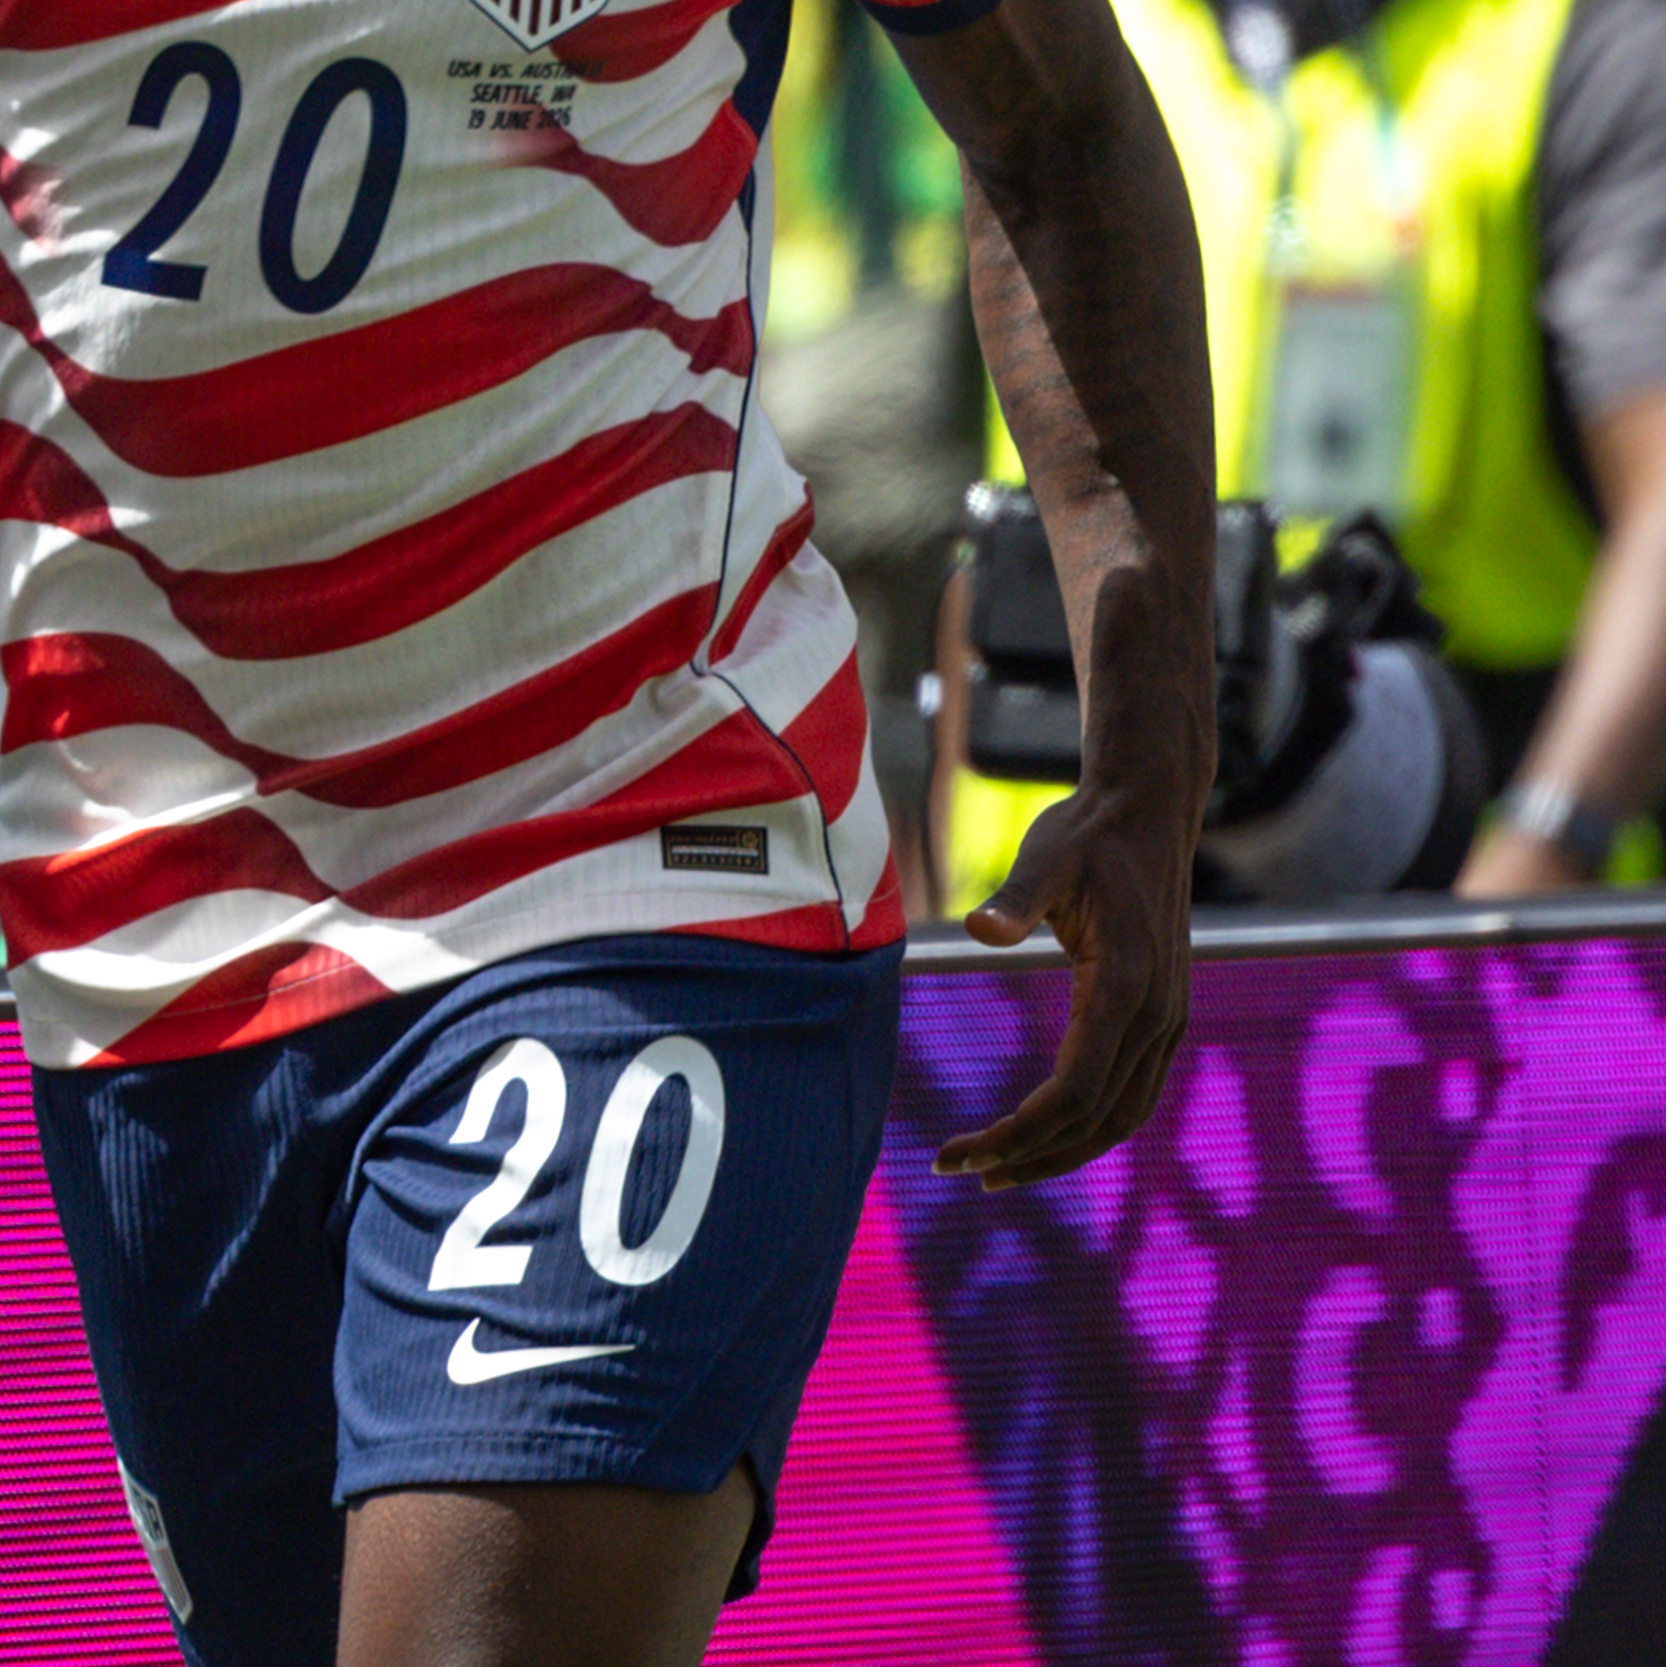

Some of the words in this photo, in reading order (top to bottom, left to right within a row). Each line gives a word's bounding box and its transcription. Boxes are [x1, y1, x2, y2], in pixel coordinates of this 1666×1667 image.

[447, 59, 482, 79] USA
[468, 108, 486, 130] 19
[490, 109, 534, 130] JUNE
[100, 40, 409, 315] 20
[428, 1035, 725, 1291] 20
